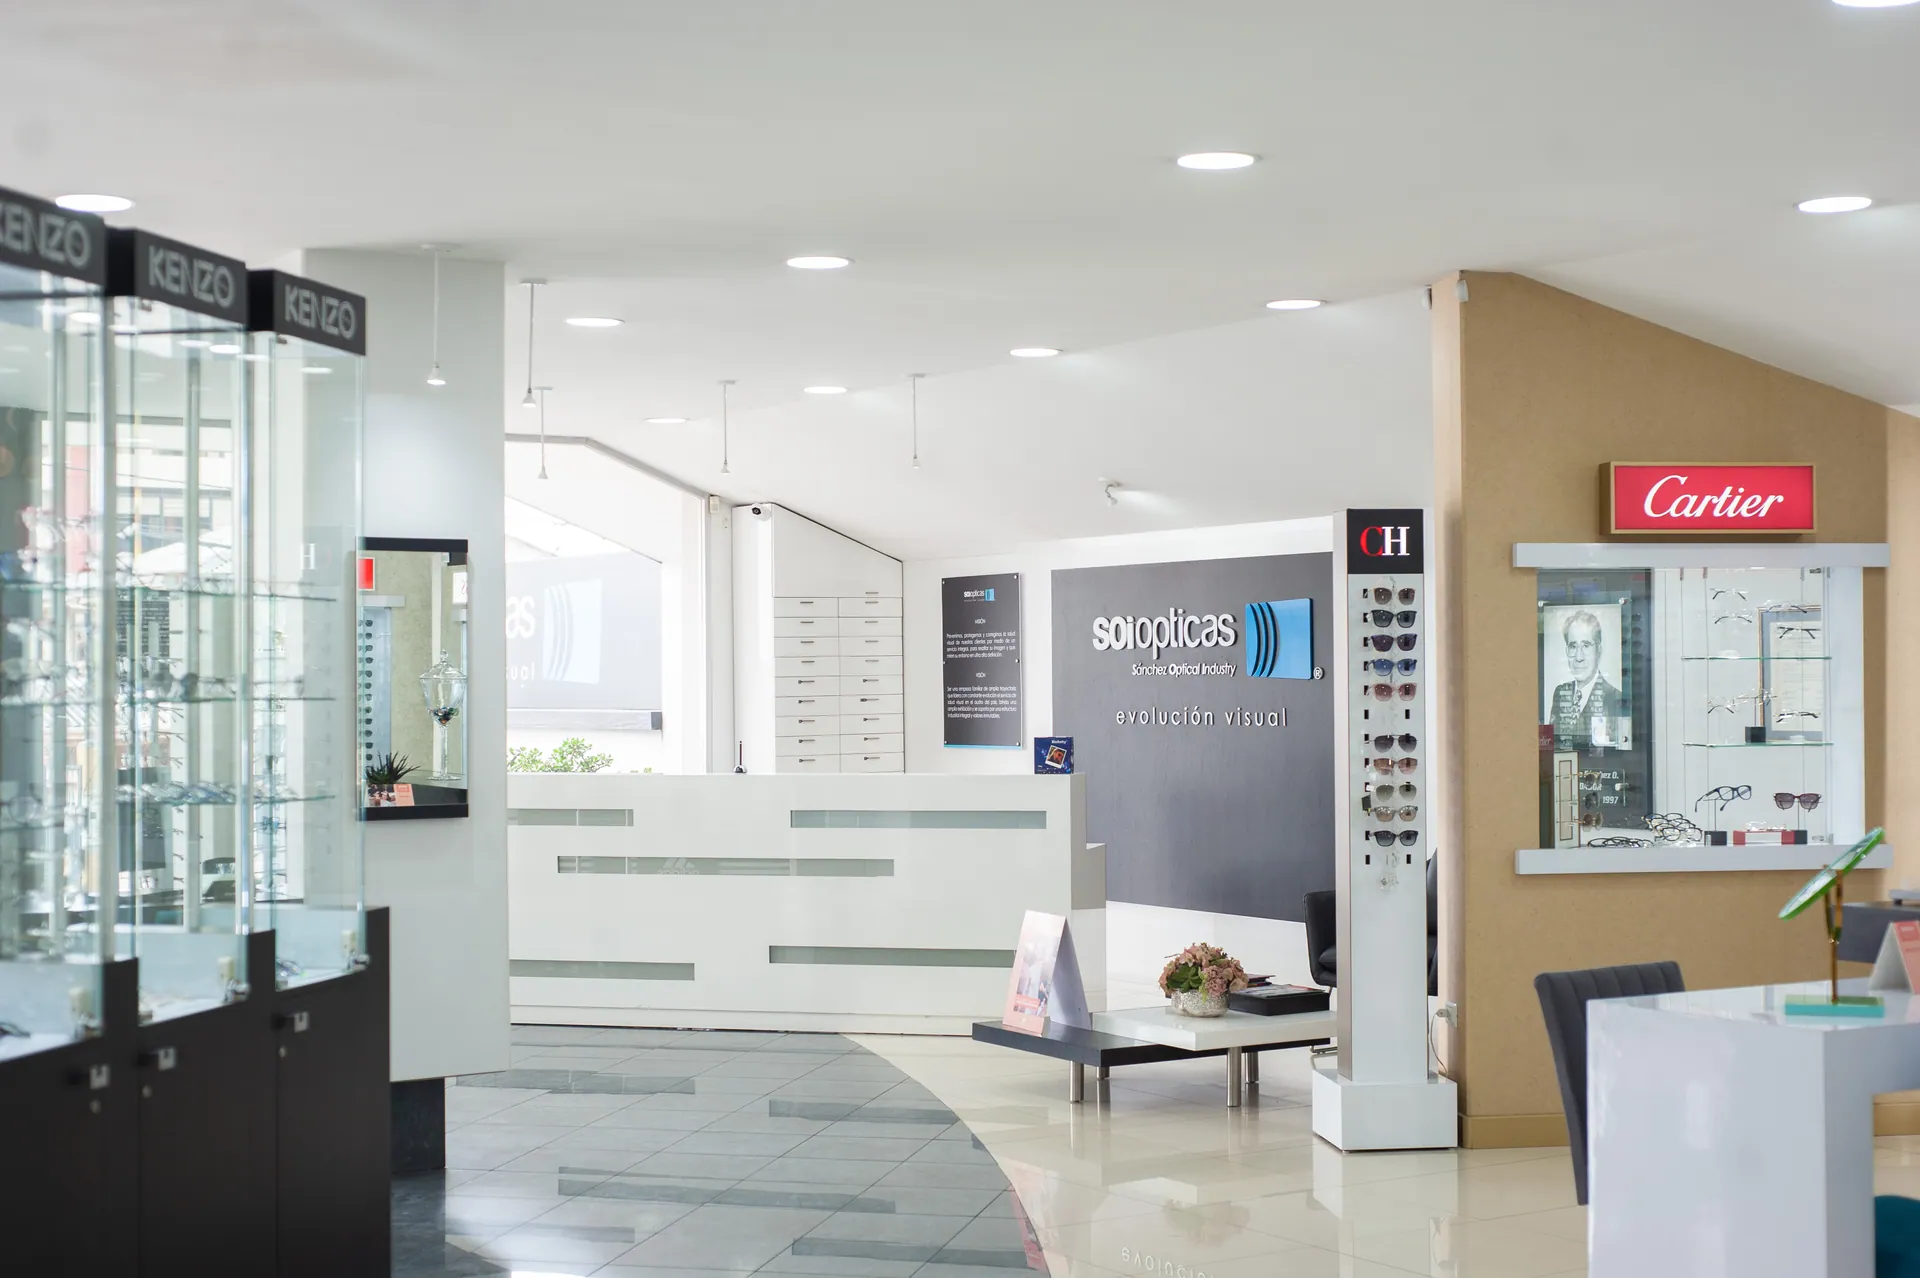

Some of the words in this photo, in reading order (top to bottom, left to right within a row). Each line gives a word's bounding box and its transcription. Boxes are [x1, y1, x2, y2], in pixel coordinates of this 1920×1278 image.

[0, 203, 91, 268] ENZO
[148, 245, 235, 309] KENZO
[284, 283, 357, 340] KENZO
[1643, 474, 1784, 519] Cartier
[1359, 525, 1411, 557] CH
[1092, 607, 1237, 660] soiopticas
[1132, 662, 1168, 676] Sánchez
[1169, 662, 1200, 677] Optical
[1202, 662, 1236, 677] Industry
[1116, 706, 1215, 726] evolución
[1225, 707, 1288, 726] visual
[1602, 796, 1619, 804] 1997
